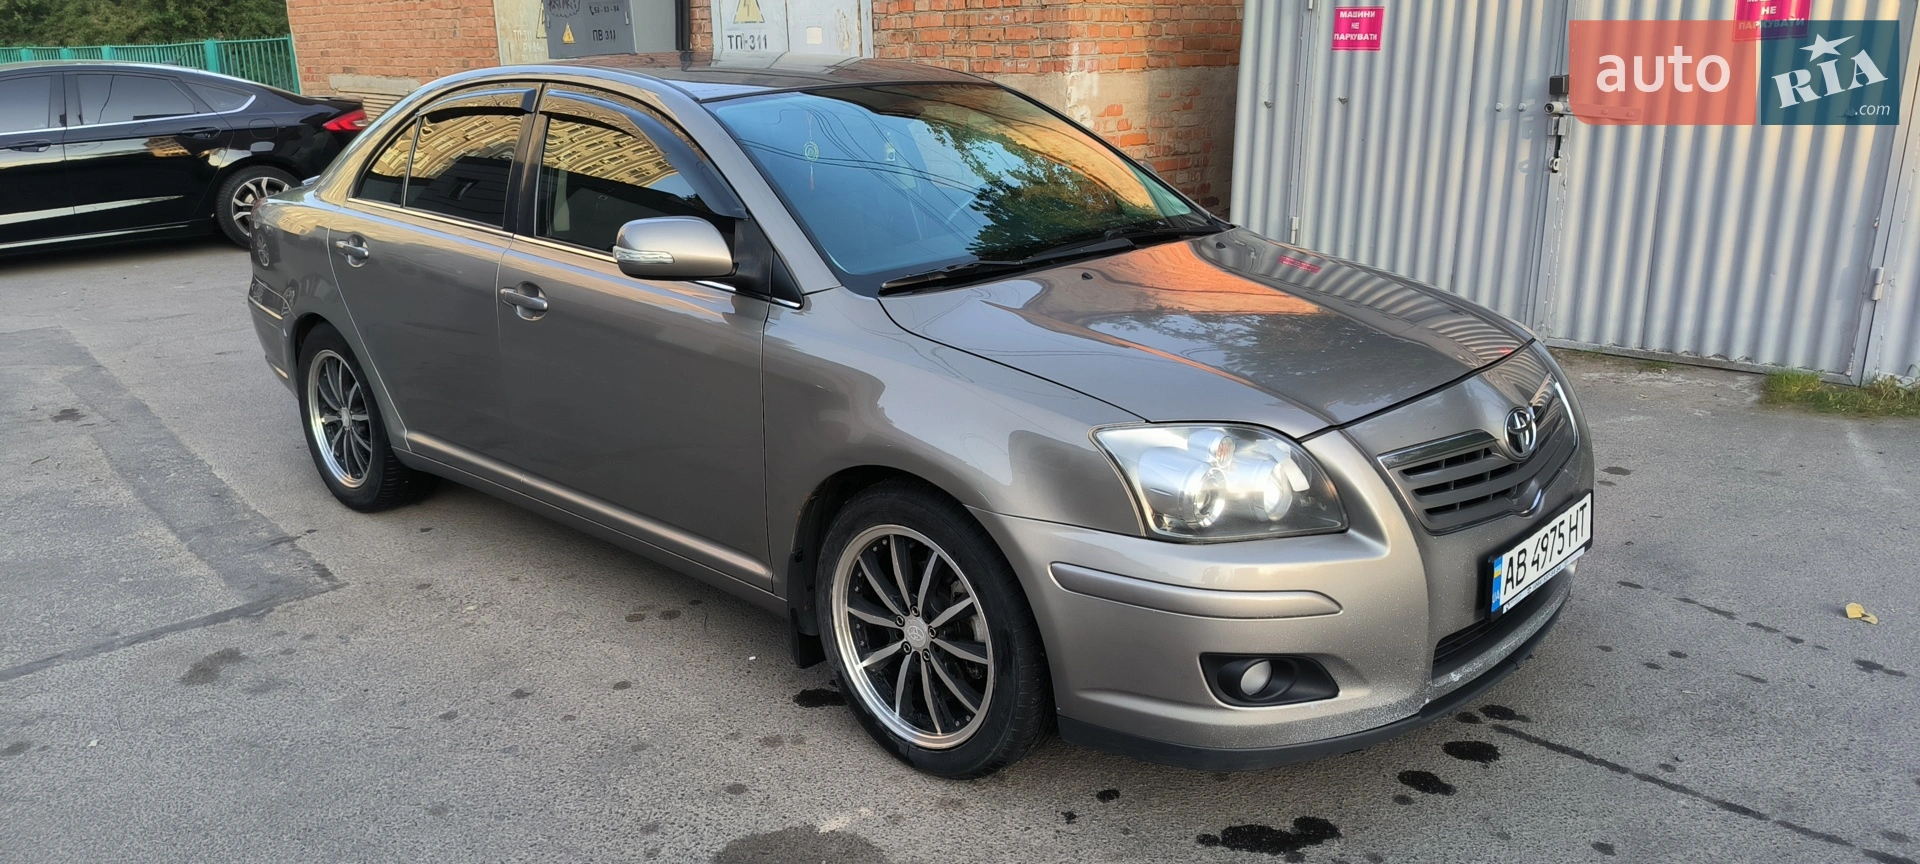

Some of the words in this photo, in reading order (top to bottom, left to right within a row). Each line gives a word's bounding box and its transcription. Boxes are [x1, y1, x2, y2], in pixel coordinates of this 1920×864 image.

[1340, 10, 1376, 18] МАШИНИ
[1761, 6, 1777, 15] НЕ
[1351, 22, 1360, 30] НЕ
[1738, 18, 1805, 30] ПАРКУВАТИ
[1333, 33, 1378, 41] ПАРКУВАТИ
[1504, 548, 1527, 596] AB
[1531, 519, 1566, 572] 4975
[1568, 503, 1588, 548] HT
